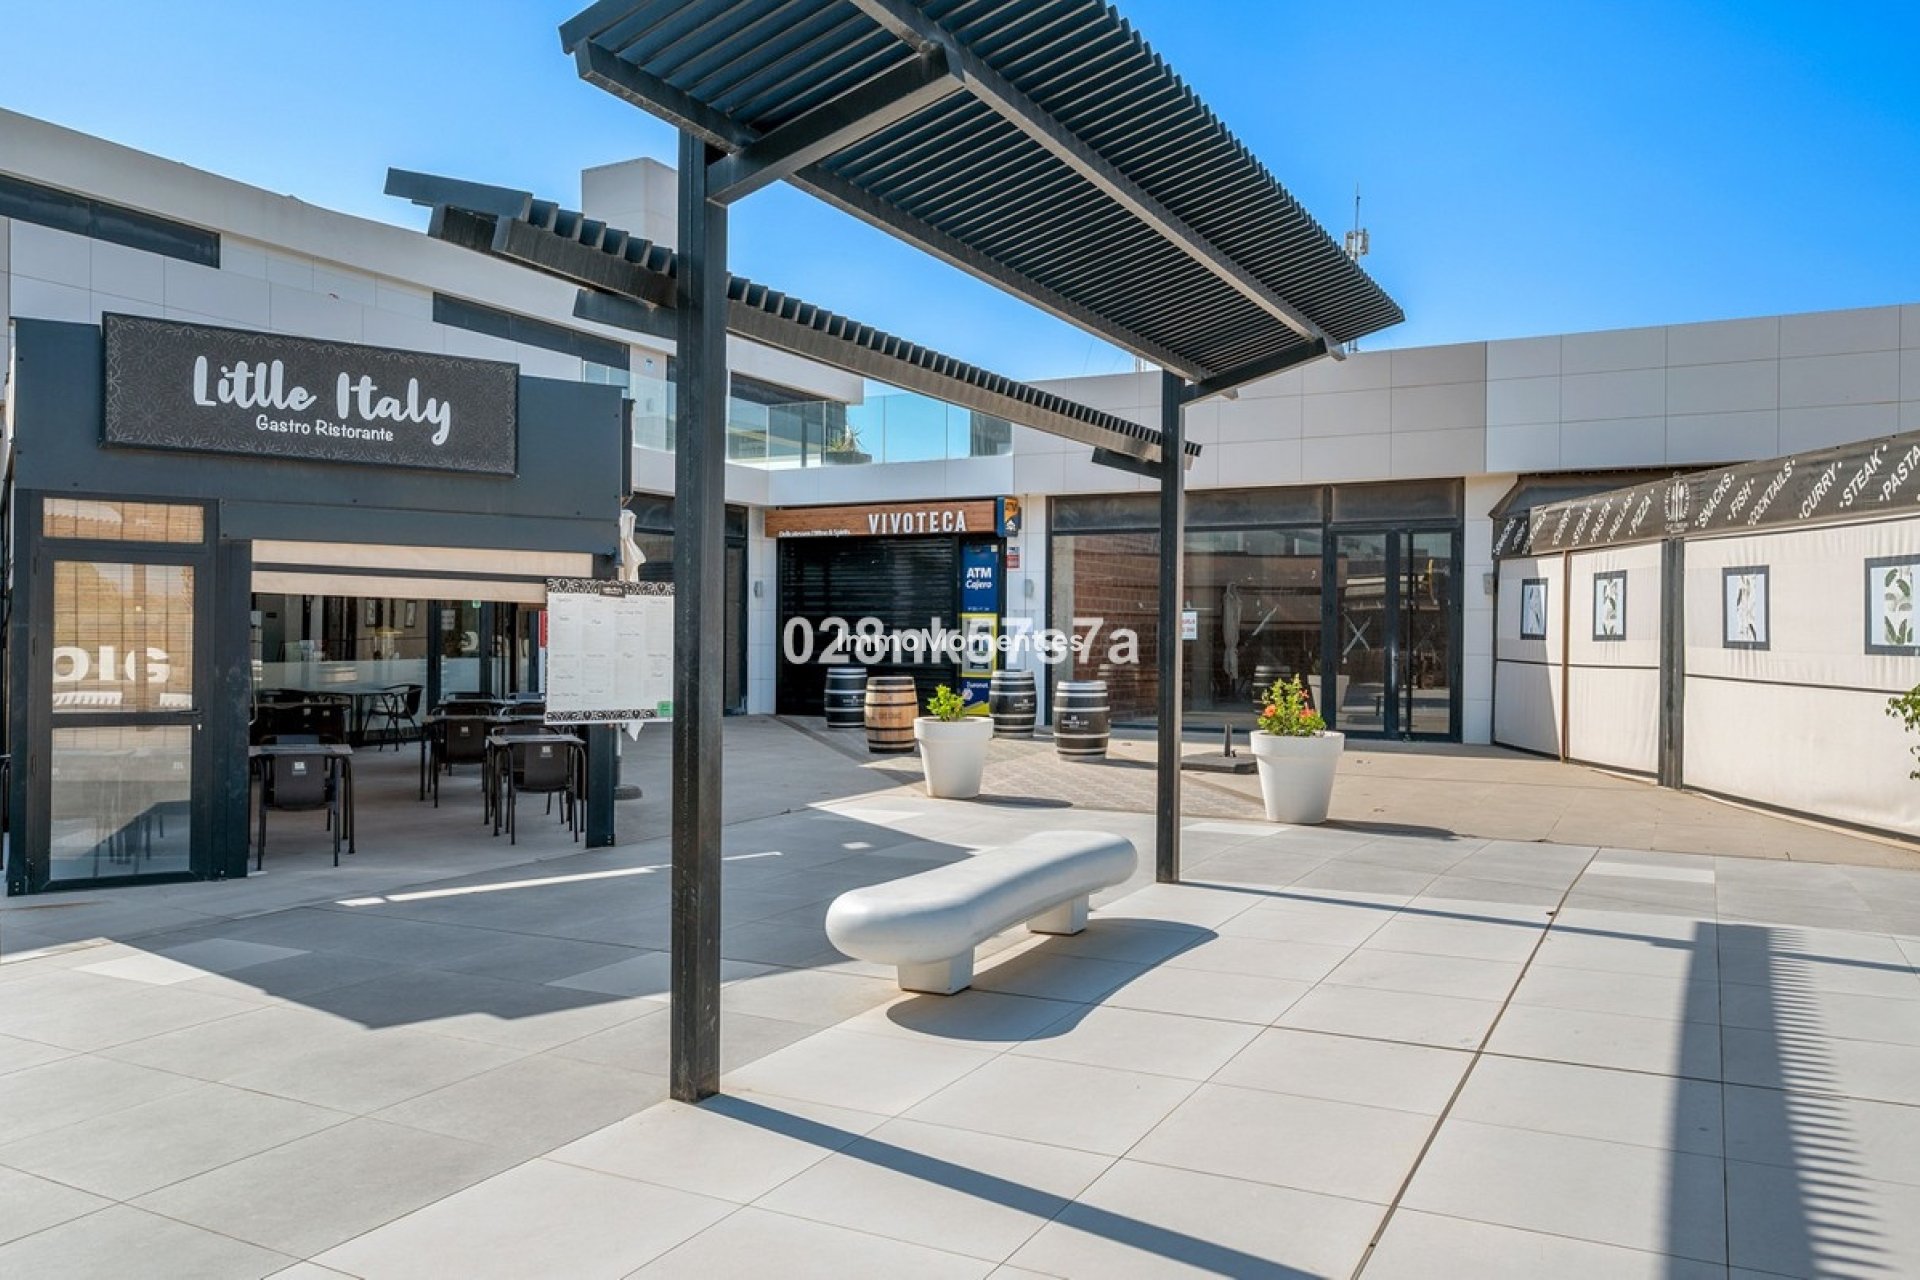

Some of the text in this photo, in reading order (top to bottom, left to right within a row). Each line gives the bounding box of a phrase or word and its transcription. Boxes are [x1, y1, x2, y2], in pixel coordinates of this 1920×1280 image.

[336, 372, 451, 446] Italy
[255, 414, 394, 442] Gastro Ristorante
[1699, 445, 1920, 529] SNACKS FISH COCKTAILS CURRY STEAK PASTA
[867, 510, 967, 535] VIVOTECA
[965, 579, 993, 591] Cajero
[966, 567, 992, 579] ATM
